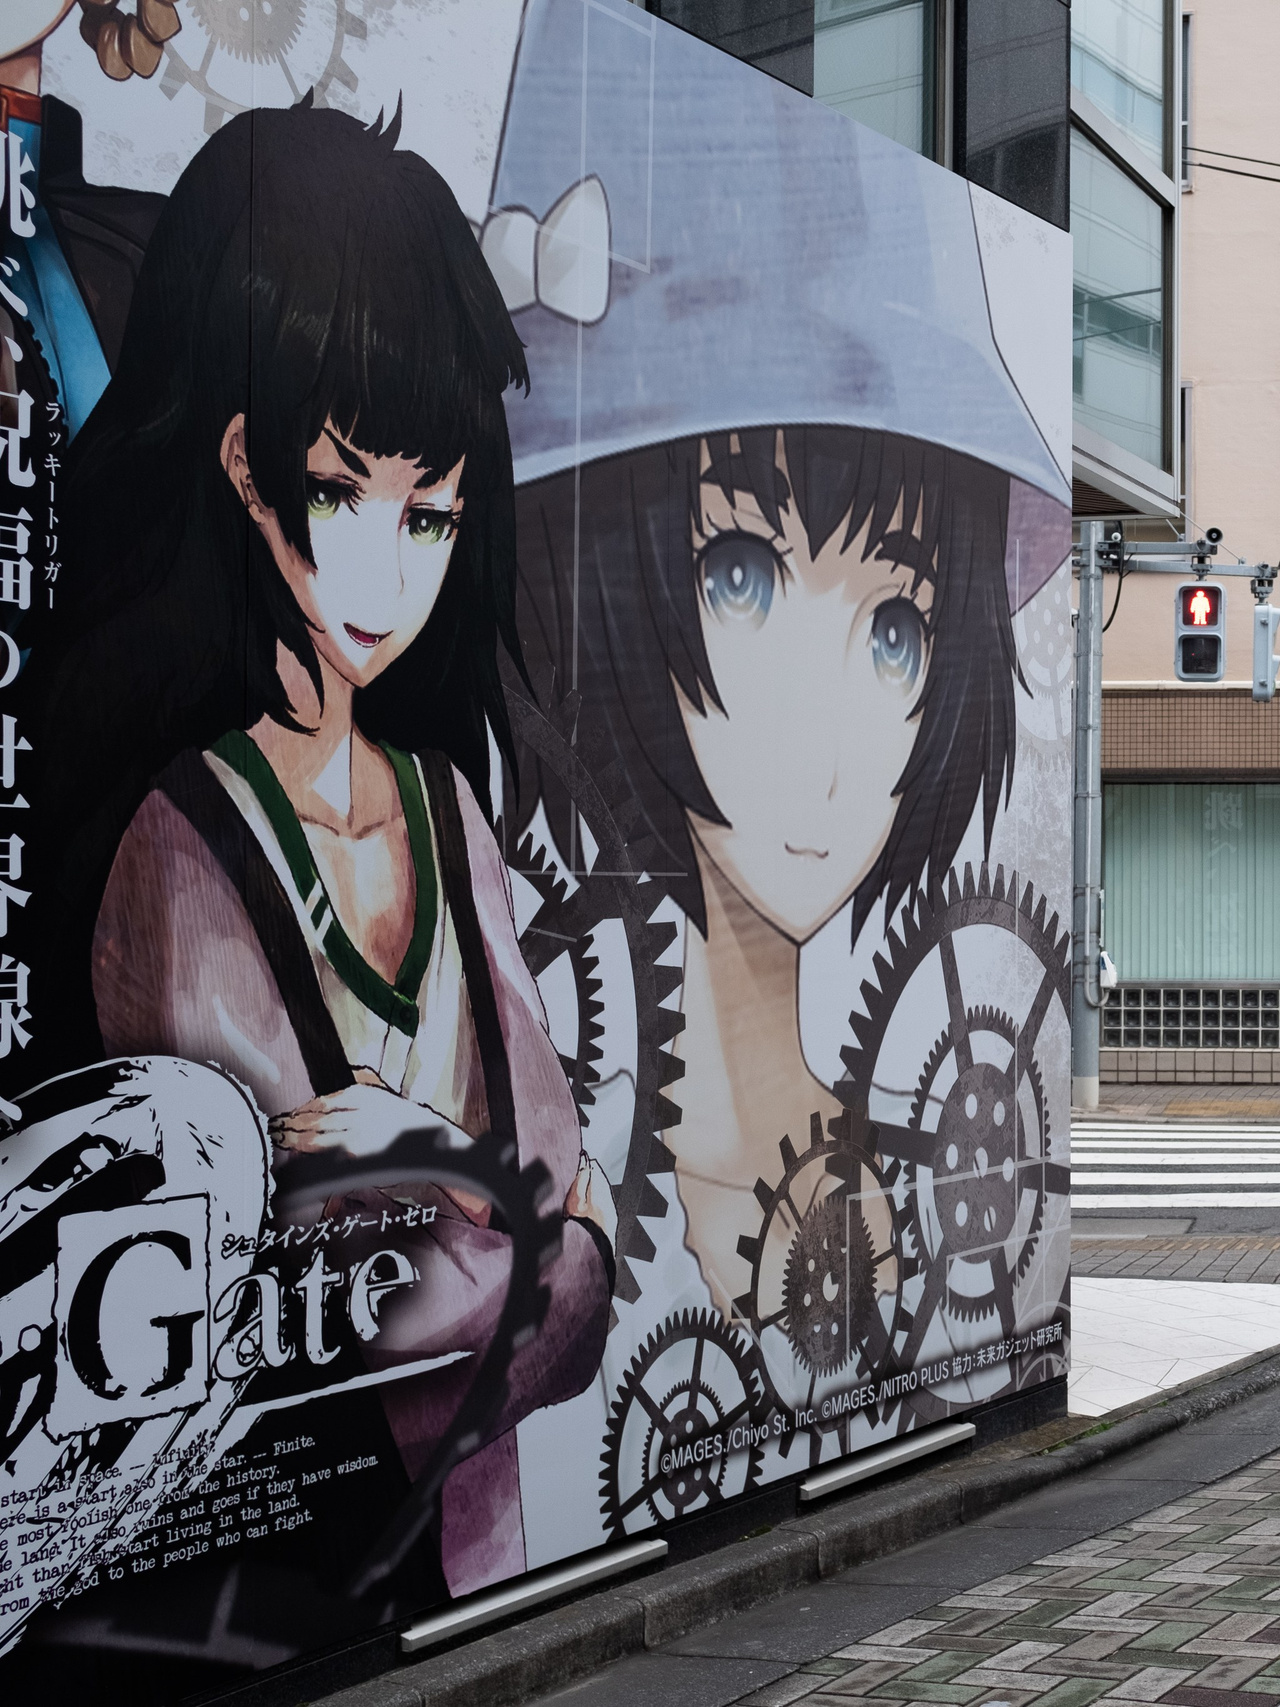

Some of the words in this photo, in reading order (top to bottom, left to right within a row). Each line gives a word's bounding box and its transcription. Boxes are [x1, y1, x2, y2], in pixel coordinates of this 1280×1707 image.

[44, 401, 62, 609] ラッキートリガー
[222, 1204, 438, 1259] シュタインズ・ゲート・ゼロ
[66, 1230, 420, 1401] Gate
[773, 1414, 790, 1436] St.
[795, 1408, 818, 1429] Inc.
[921, 1361, 949, 1387] PLUS
[17, 1522, 54, 1547] most
[126, 1498, 152, 1515] one
[157, 1487, 191, 1507] from
[198, 1480, 221, 1495] the
[226, 1464, 281, 1488] history.
[34, 1505, 50, 1521] is
[57, 1501, 67, 1514] a
[73, 1484, 118, 1510] start
[125, 1478, 156, 1497] also
[163, 1470, 178, 1485] in
[214, 1454, 247, 1472] star.
[273, 1434, 316, 1457] Finite.
[70, 1534, 86, 1552] It
[180, 1500, 205, 1520] and
[211, 1492, 241, 1514] goes
[246, 1486, 260, 1501] if
[266, 1478, 296, 1496] they
[301, 1468, 332, 1486] have
[32, 1562, 71, 1584] than
[166, 1521, 212, 1545] living
[218, 1514, 233, 1529] in
[240, 1506, 262, 1522] the
[268, 1494, 301, 1515] land.
[38, 1585, 66, 1604] the
[73, 1571, 100, 1596] god
[108, 1566, 125, 1581] to
[132, 1556, 156, 1574] the
[163, 1540, 210, 1568] people
[216, 1531, 241, 1548] who
[246, 1524, 269, 1539] can
[274, 1509, 314, 1532] fight.
